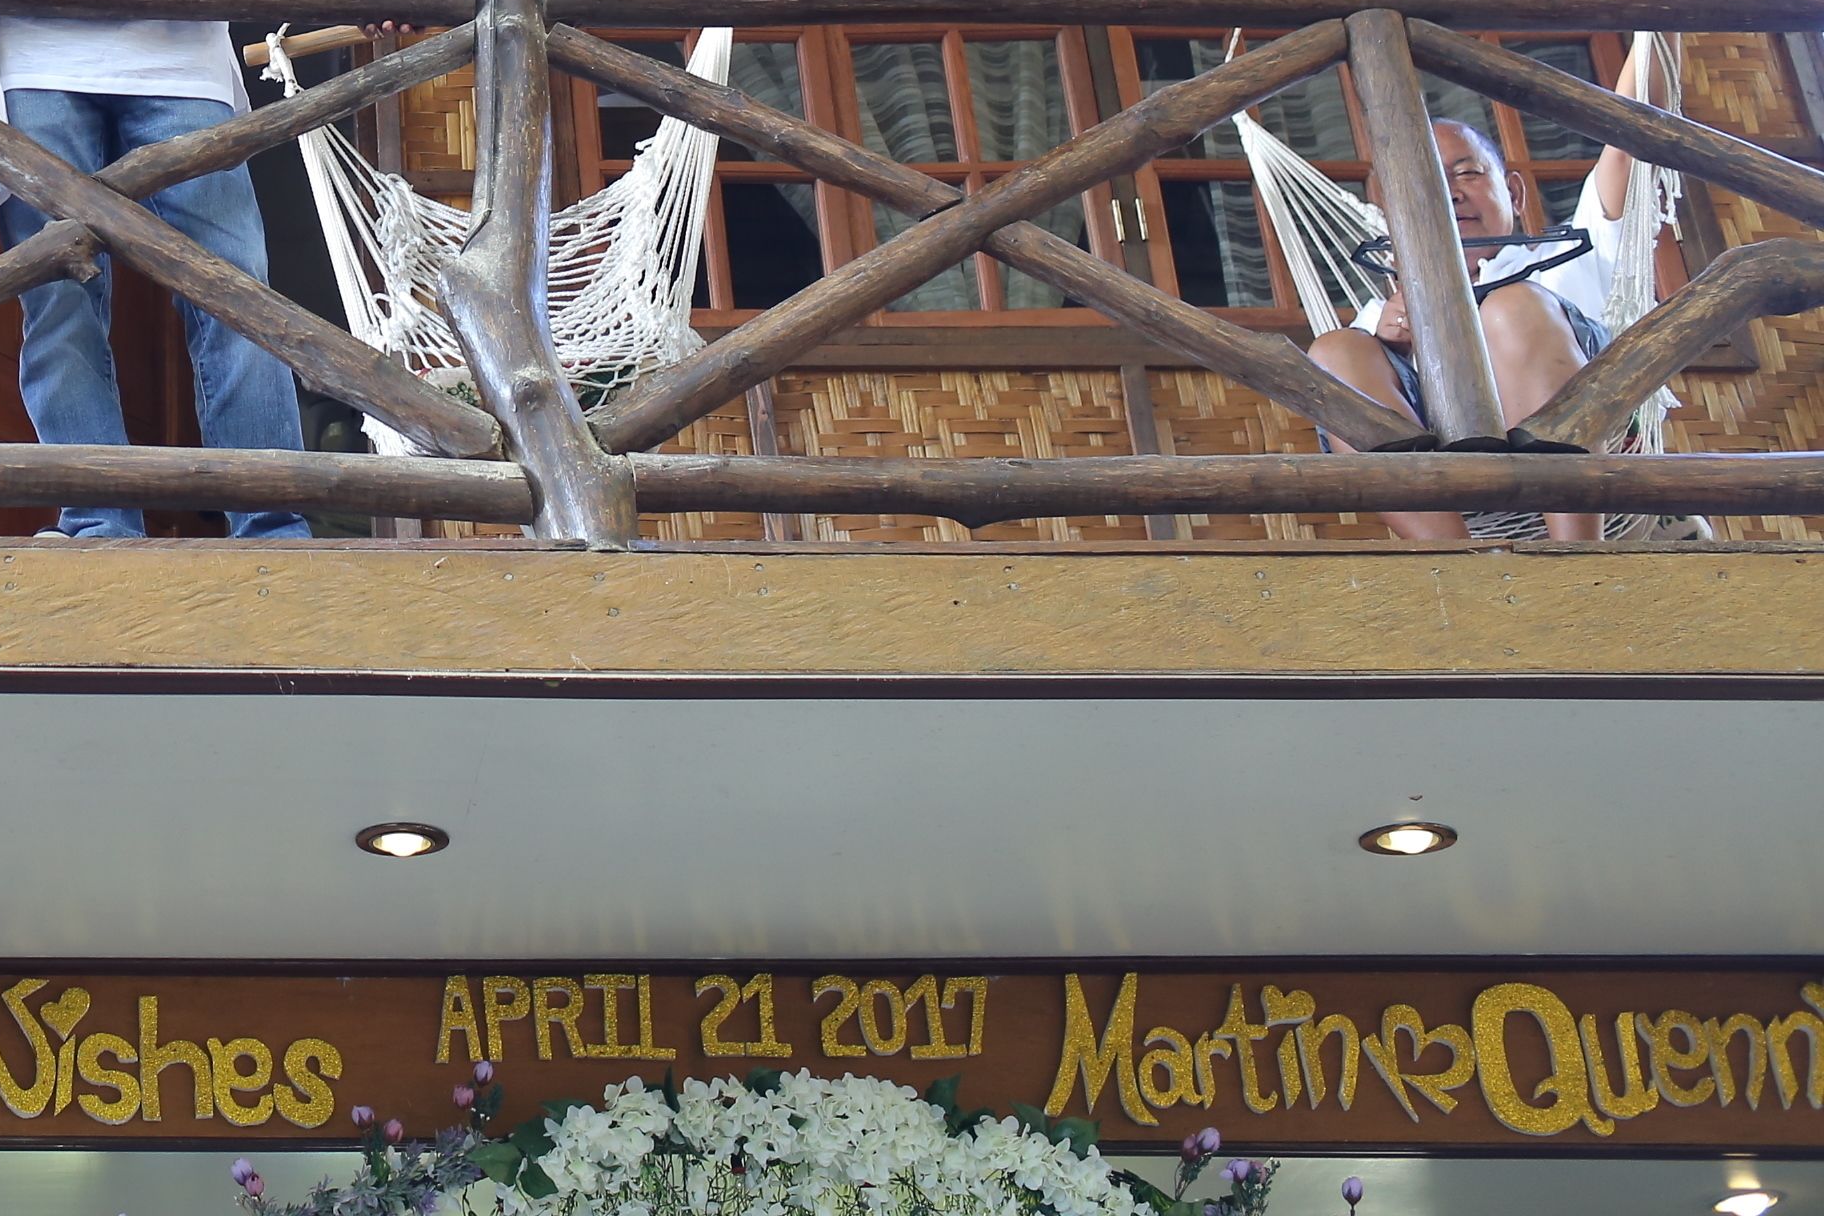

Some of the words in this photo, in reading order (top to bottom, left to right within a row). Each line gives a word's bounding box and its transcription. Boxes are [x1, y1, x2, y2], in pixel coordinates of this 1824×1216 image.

[435, 974, 676, 1064] APRIL
[695, 972, 793, 1058] 21
[812, 974, 988, 1061] 2017
[1044, 972, 1360, 1126] Martin
[1473, 980, 1824, 1137] Quenn
